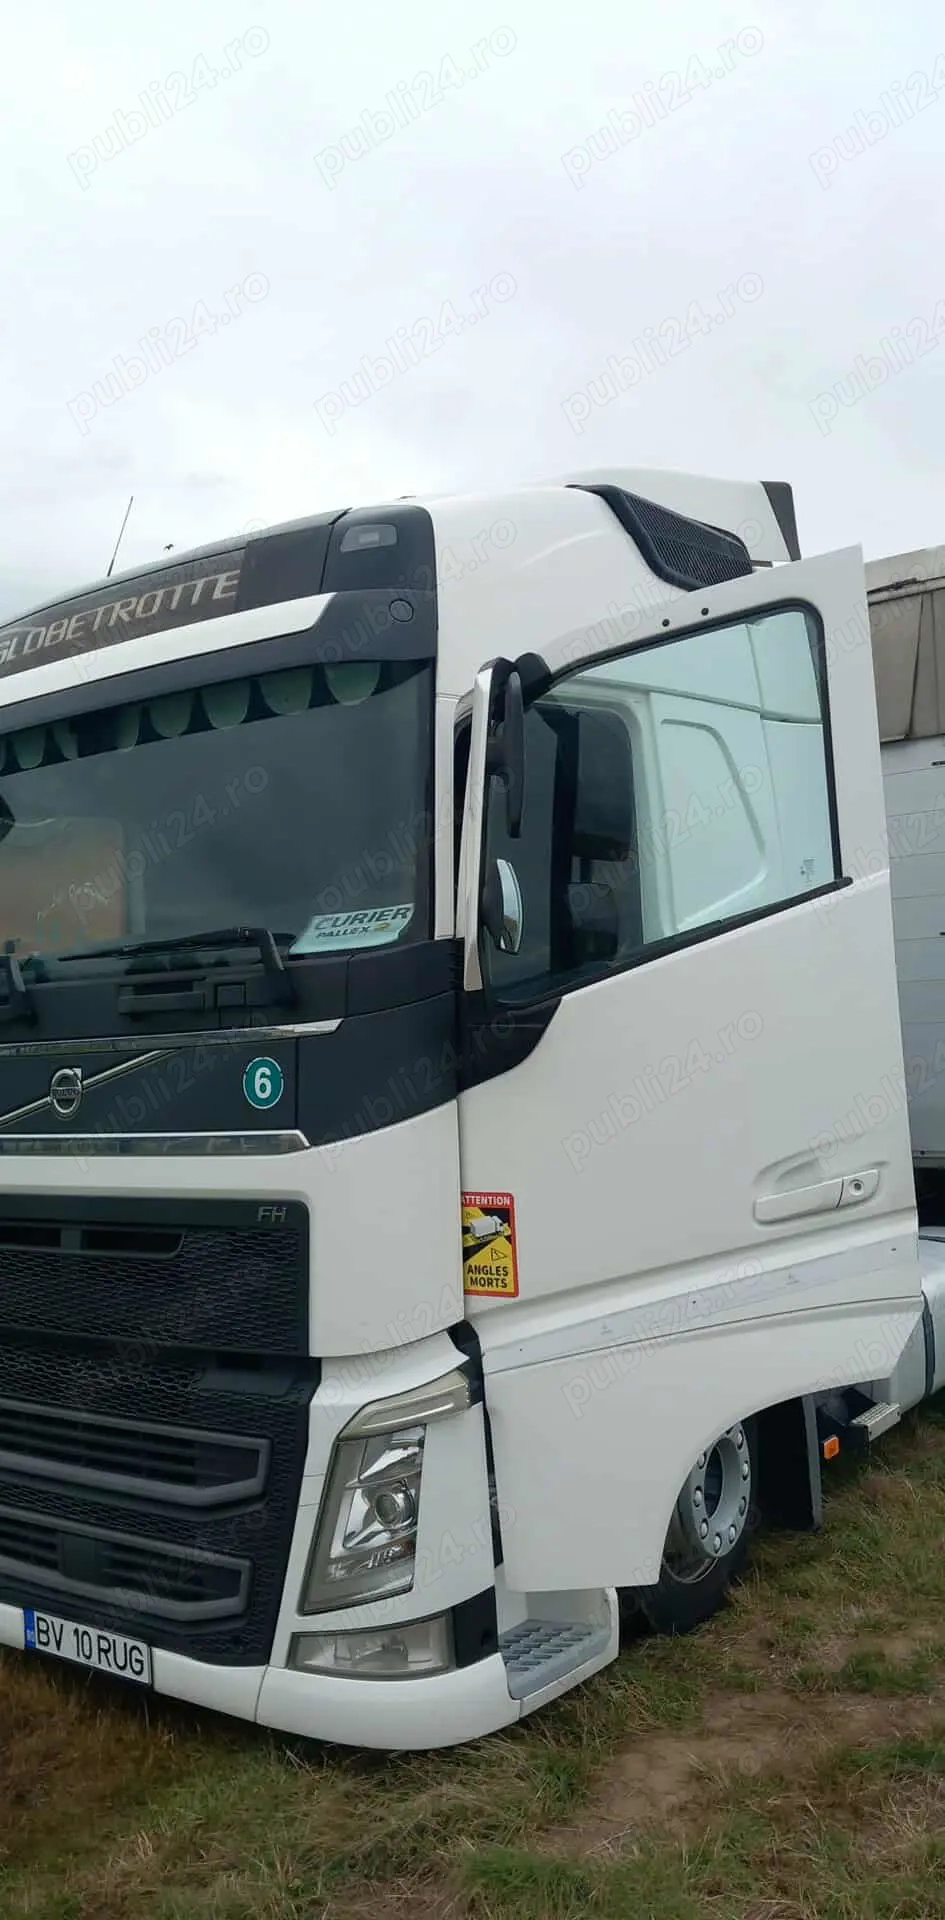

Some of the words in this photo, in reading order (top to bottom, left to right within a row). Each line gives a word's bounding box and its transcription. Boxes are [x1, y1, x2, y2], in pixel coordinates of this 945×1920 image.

[314, 907, 411, 930] CURIER
[254, 1067, 272, 1099] 6
[463, 1195, 511, 1206] TTENTION
[257, 1206, 287, 1223] FH
[467, 1264, 509, 1277] ANGLES
[469, 1276, 508, 1289] MORTS
[37, 1615, 63, 1651] BV
[73, 1627, 93, 1660] 10
[97, 1634, 145, 1676] RUG
